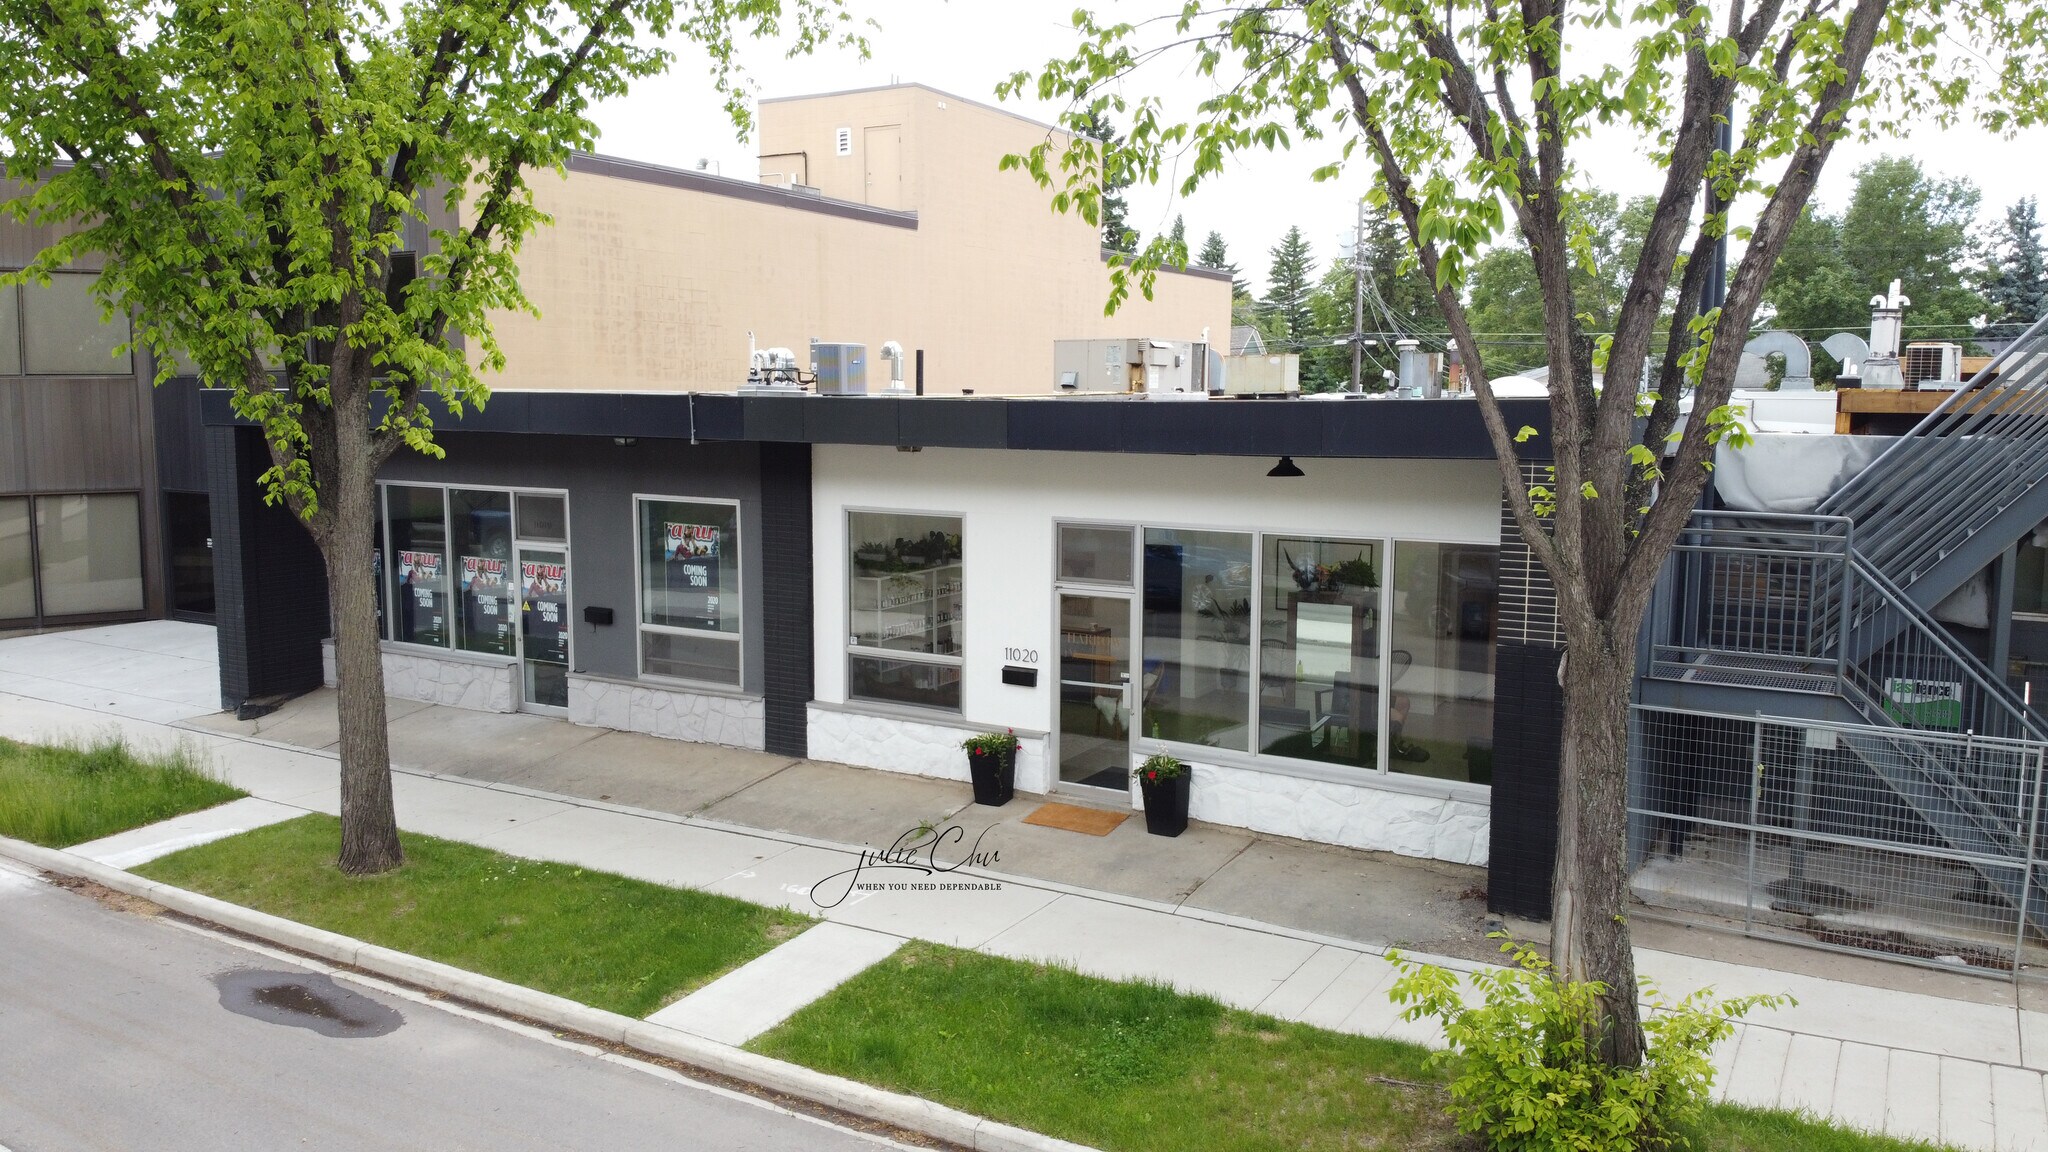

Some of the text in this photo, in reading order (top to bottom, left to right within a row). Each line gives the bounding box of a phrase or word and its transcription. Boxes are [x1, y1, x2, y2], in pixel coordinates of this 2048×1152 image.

[684, 564, 707, 576] COMING
[690, 576, 707, 587] SOON
[415, 588, 433, 598] COMING
[419, 597, 433, 608] SOON
[478, 595, 497, 605] COMING
[483, 604, 498, 615] SOON
[537, 601, 558, 612] COMING
[542, 611, 559, 623] SOON
[1005, 647, 1038, 663] 11020
